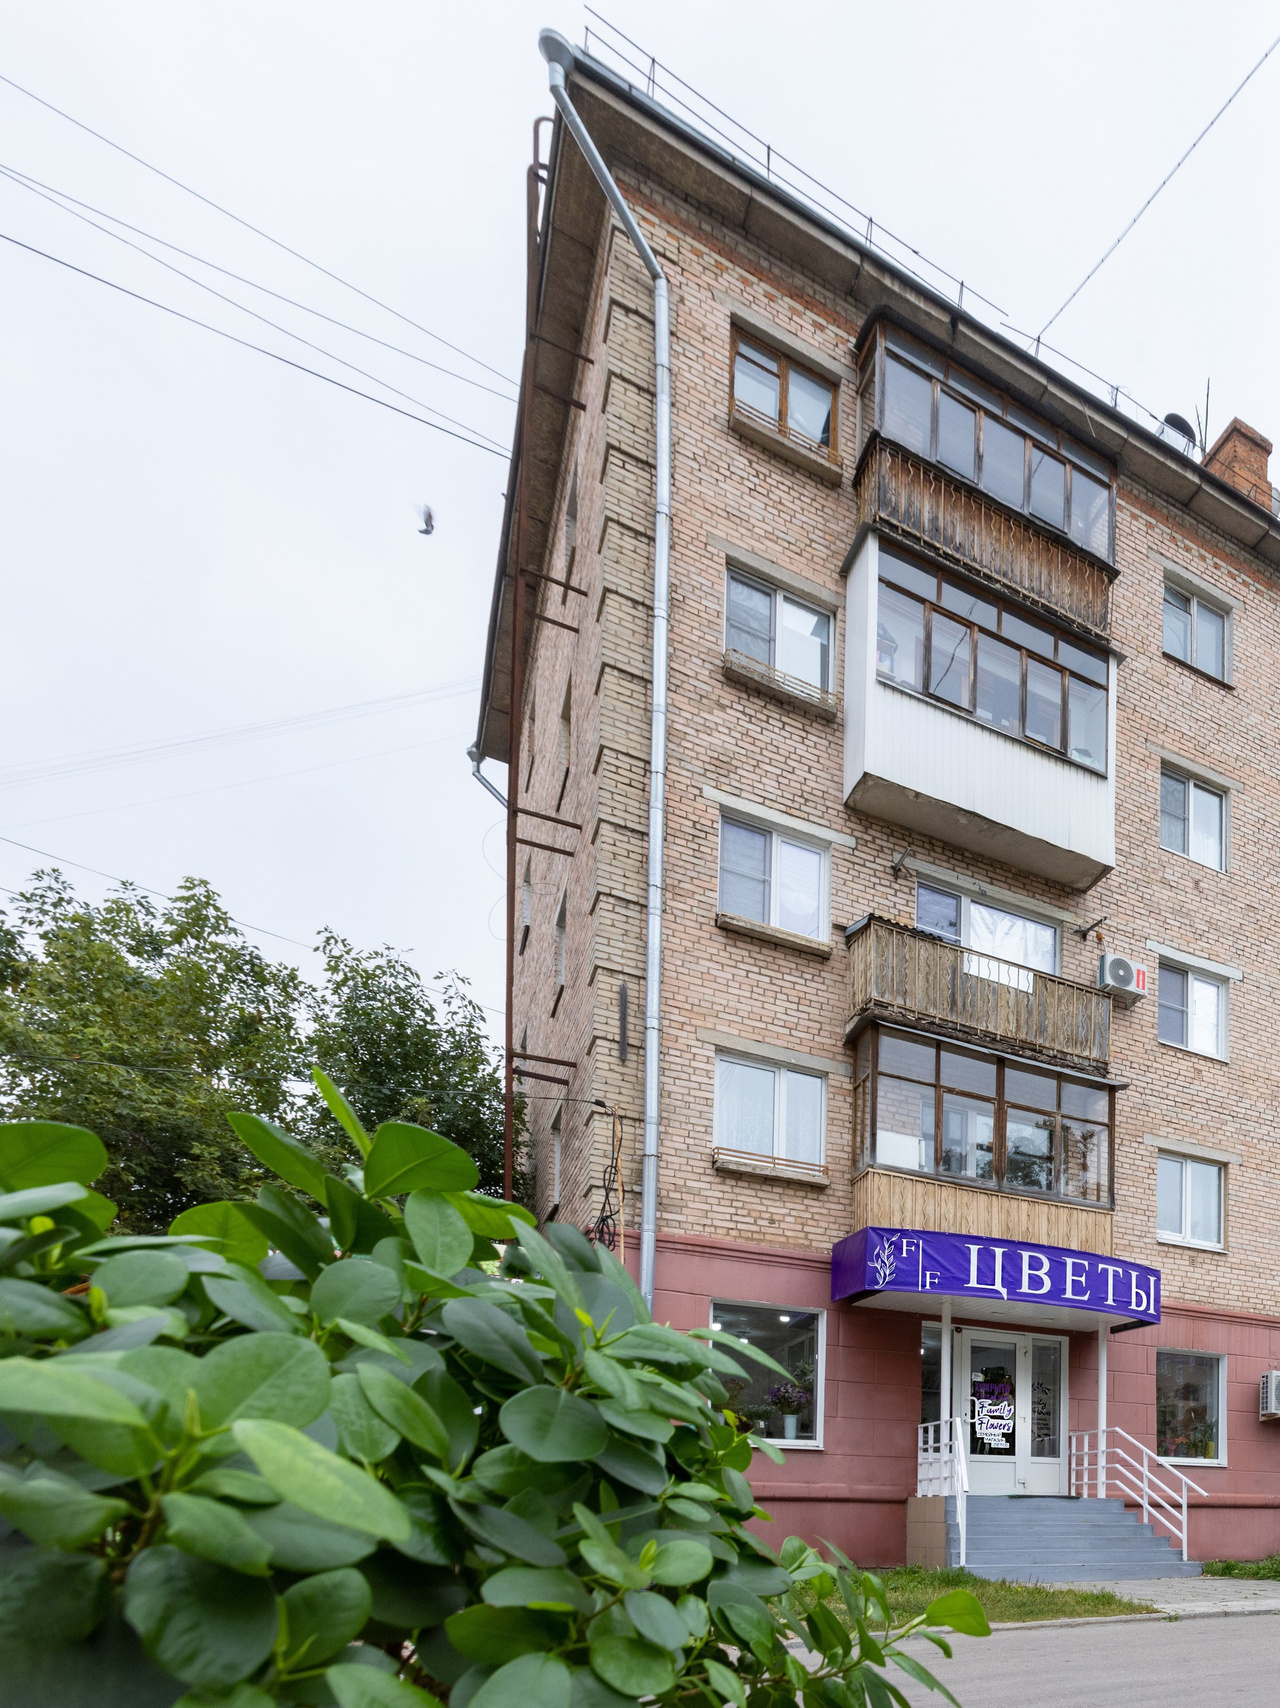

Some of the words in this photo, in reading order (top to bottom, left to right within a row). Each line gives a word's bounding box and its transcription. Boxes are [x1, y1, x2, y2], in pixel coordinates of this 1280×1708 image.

[963, 1243, 1157, 1315] ЦВЕТЫ
[979, 1400, 1012, 1417] Family
[978, 1417, 1011, 1432] Flowers
